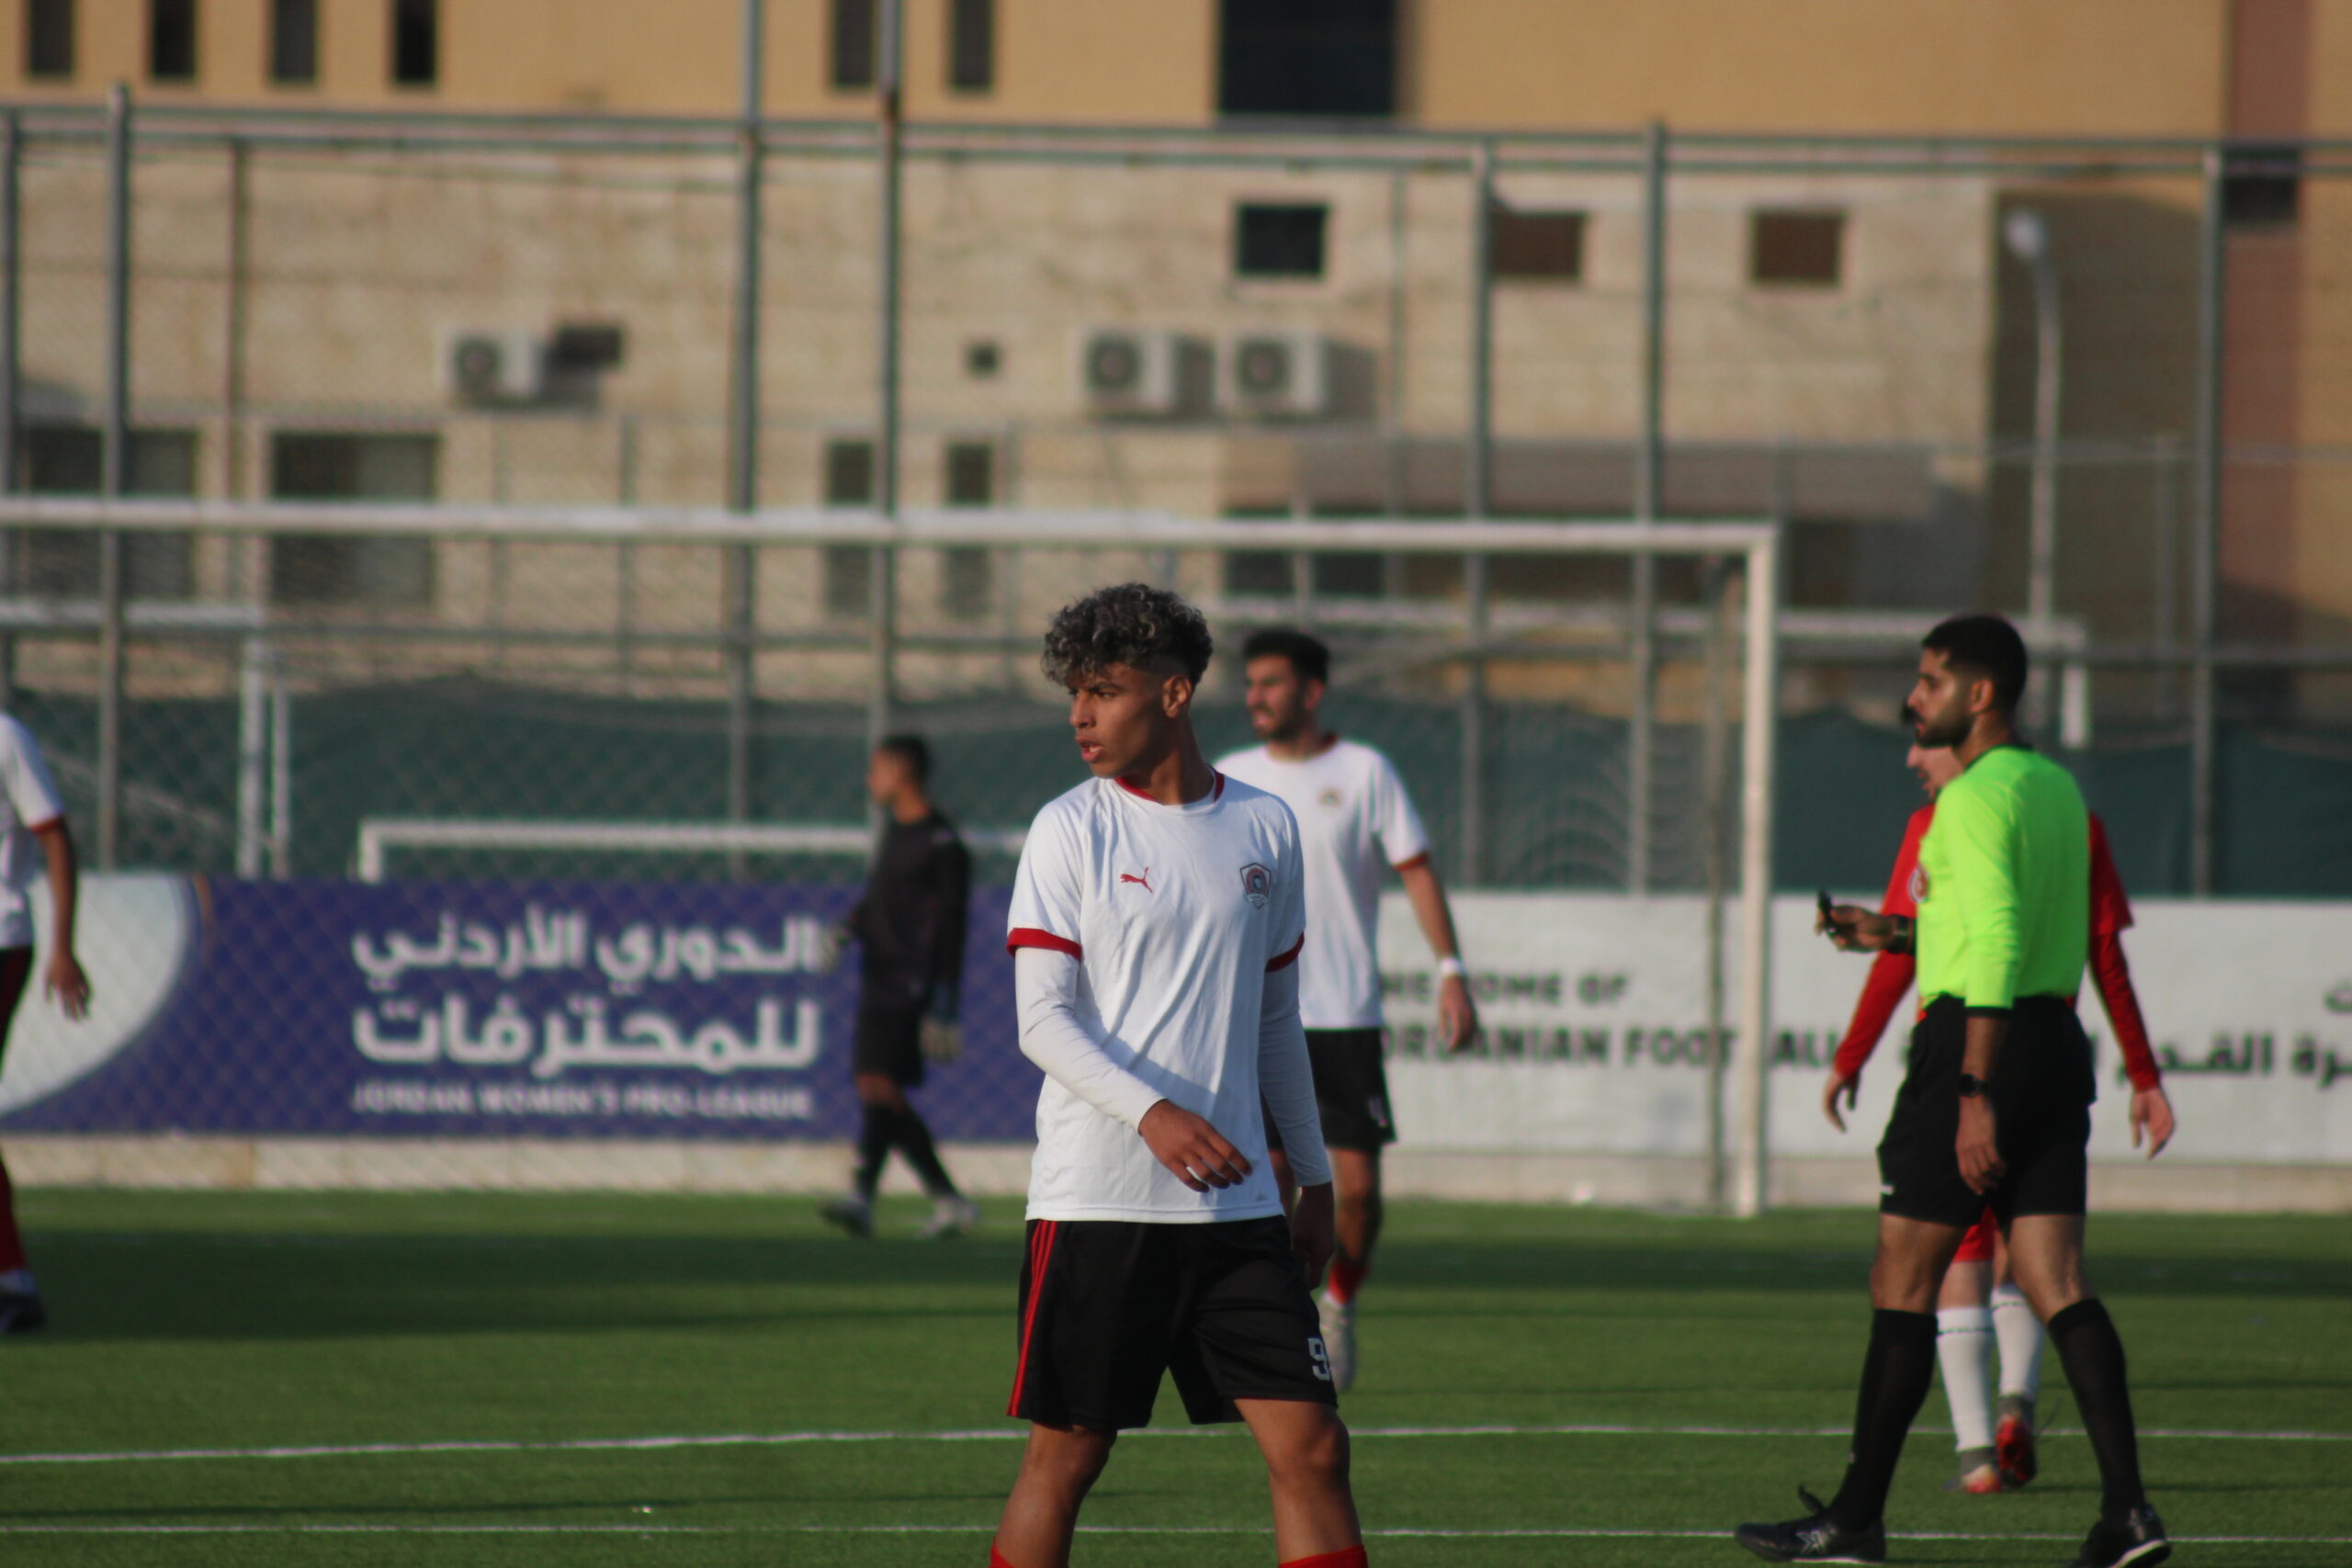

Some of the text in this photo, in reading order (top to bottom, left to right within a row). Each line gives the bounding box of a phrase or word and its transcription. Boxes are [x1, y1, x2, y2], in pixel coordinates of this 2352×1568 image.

[351, 902, 821, 995] الدوري الأردني
[1379, 971, 1430, 1001] HE
[1476, 972, 1561, 1004] OME
[352, 993, 821, 1077] للمحترفات
[1381, 1023, 1837, 1068] ORANIAN FOOTAL
[354, 1081, 475, 1114] JORDAN
[696, 1087, 810, 1120] LEAGUE
[1307, 1337, 1330, 1381] 9
